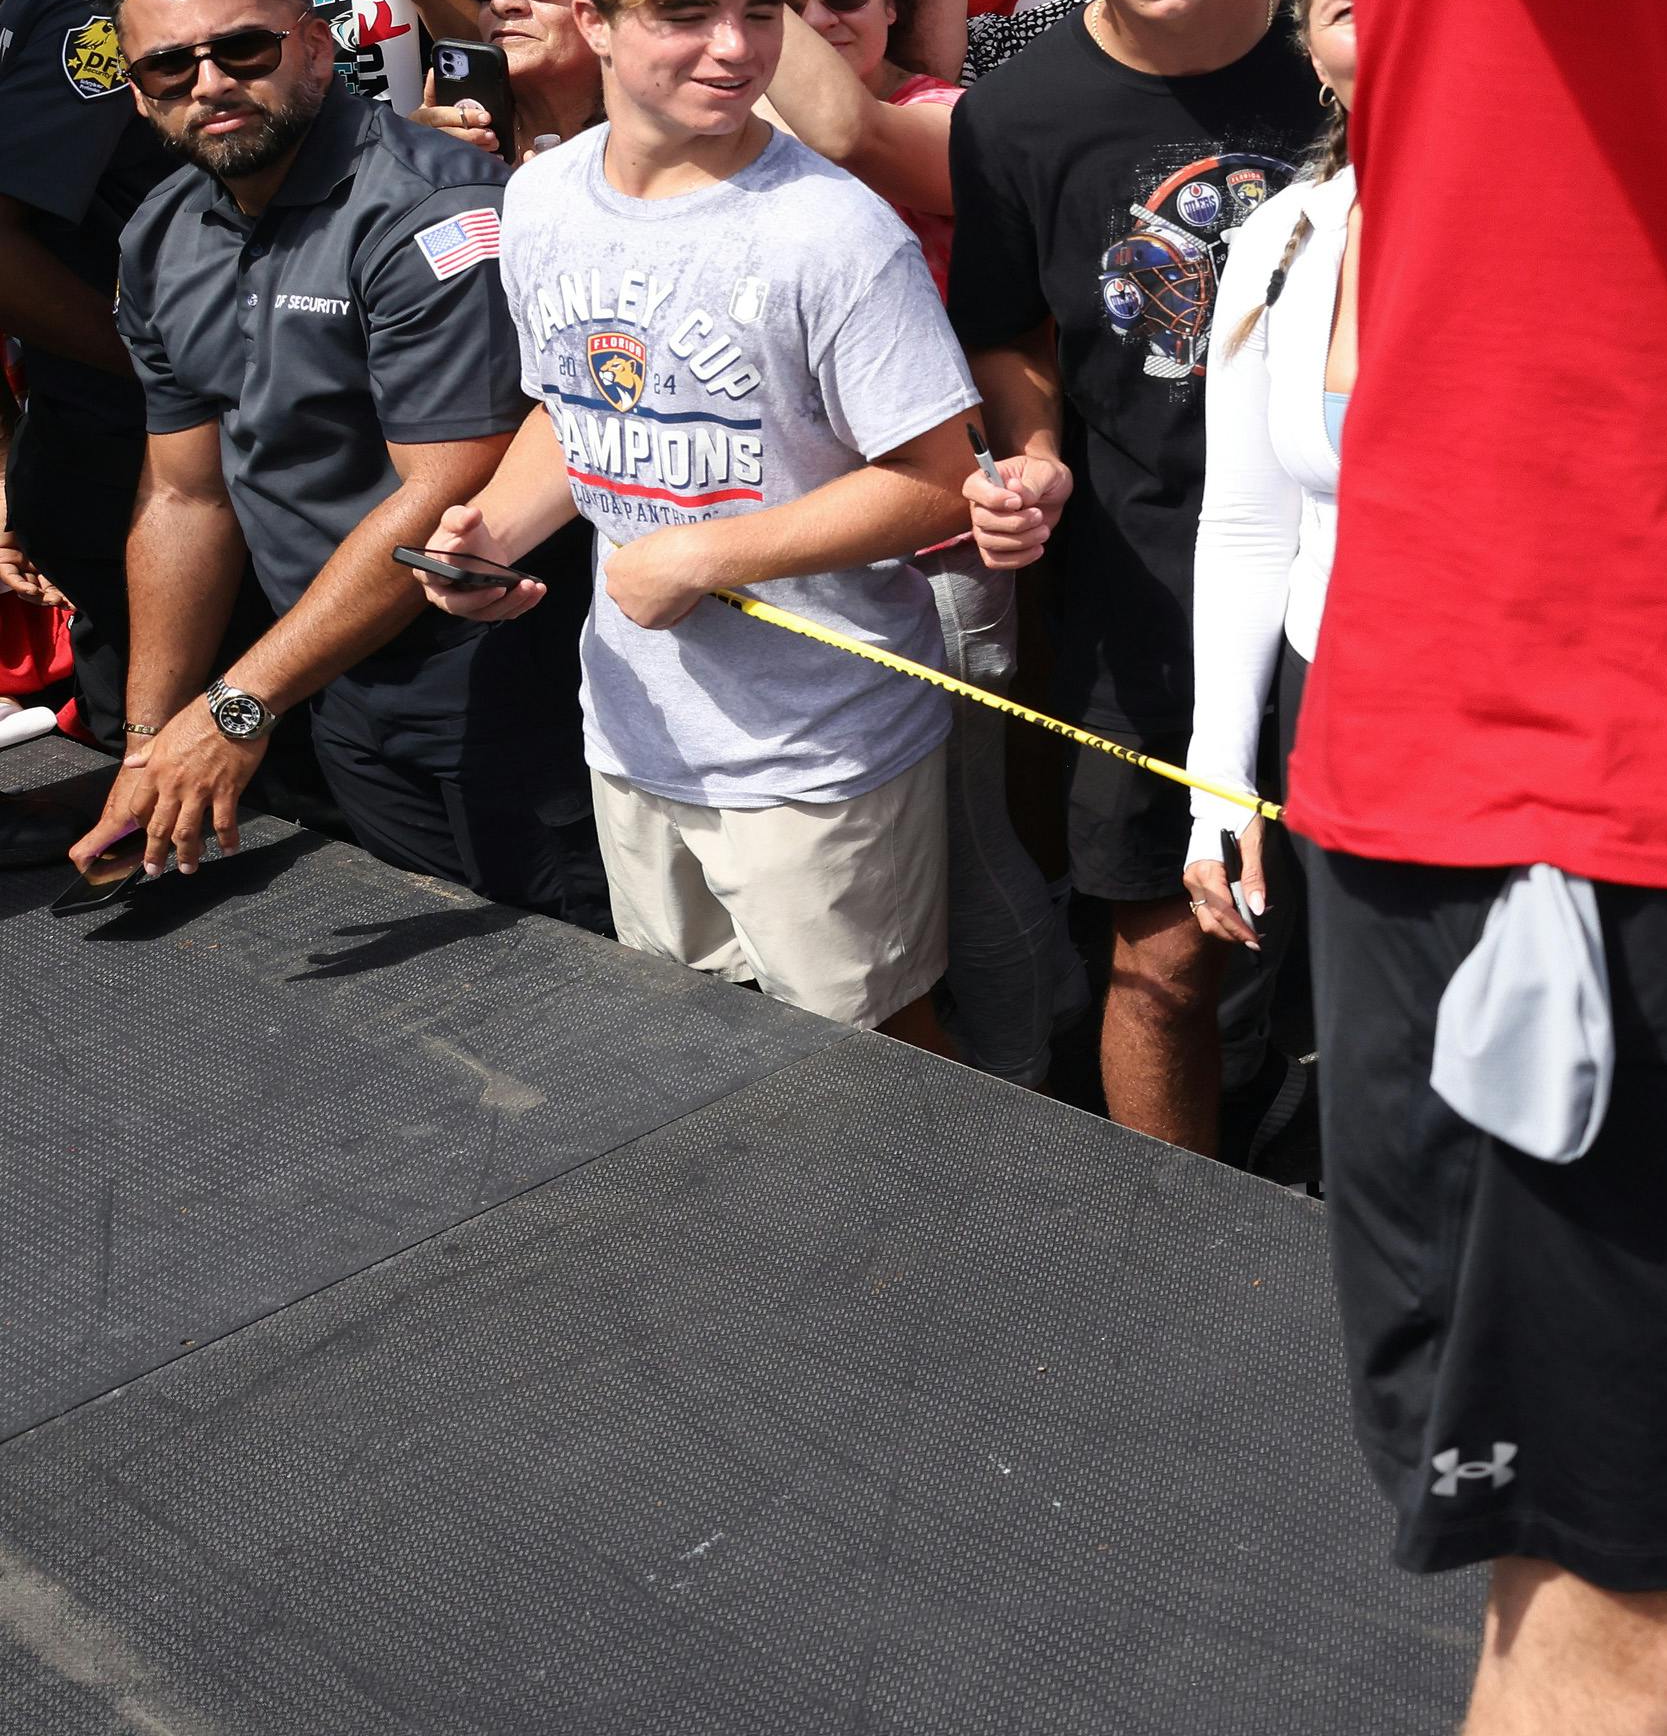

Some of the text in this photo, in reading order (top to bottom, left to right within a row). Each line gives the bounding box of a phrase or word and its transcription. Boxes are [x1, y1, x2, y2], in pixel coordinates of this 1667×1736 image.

[85, 50, 118, 72] DF
[82, 65, 112, 80] Security
[1183, 194, 1217, 218] OILERS
[275, 294, 350, 316] DF SECURITY
[593, 336, 643, 358] FLORIDA
[669, 311, 763, 401] CUP
[558, 355, 675, 395] 20 24
